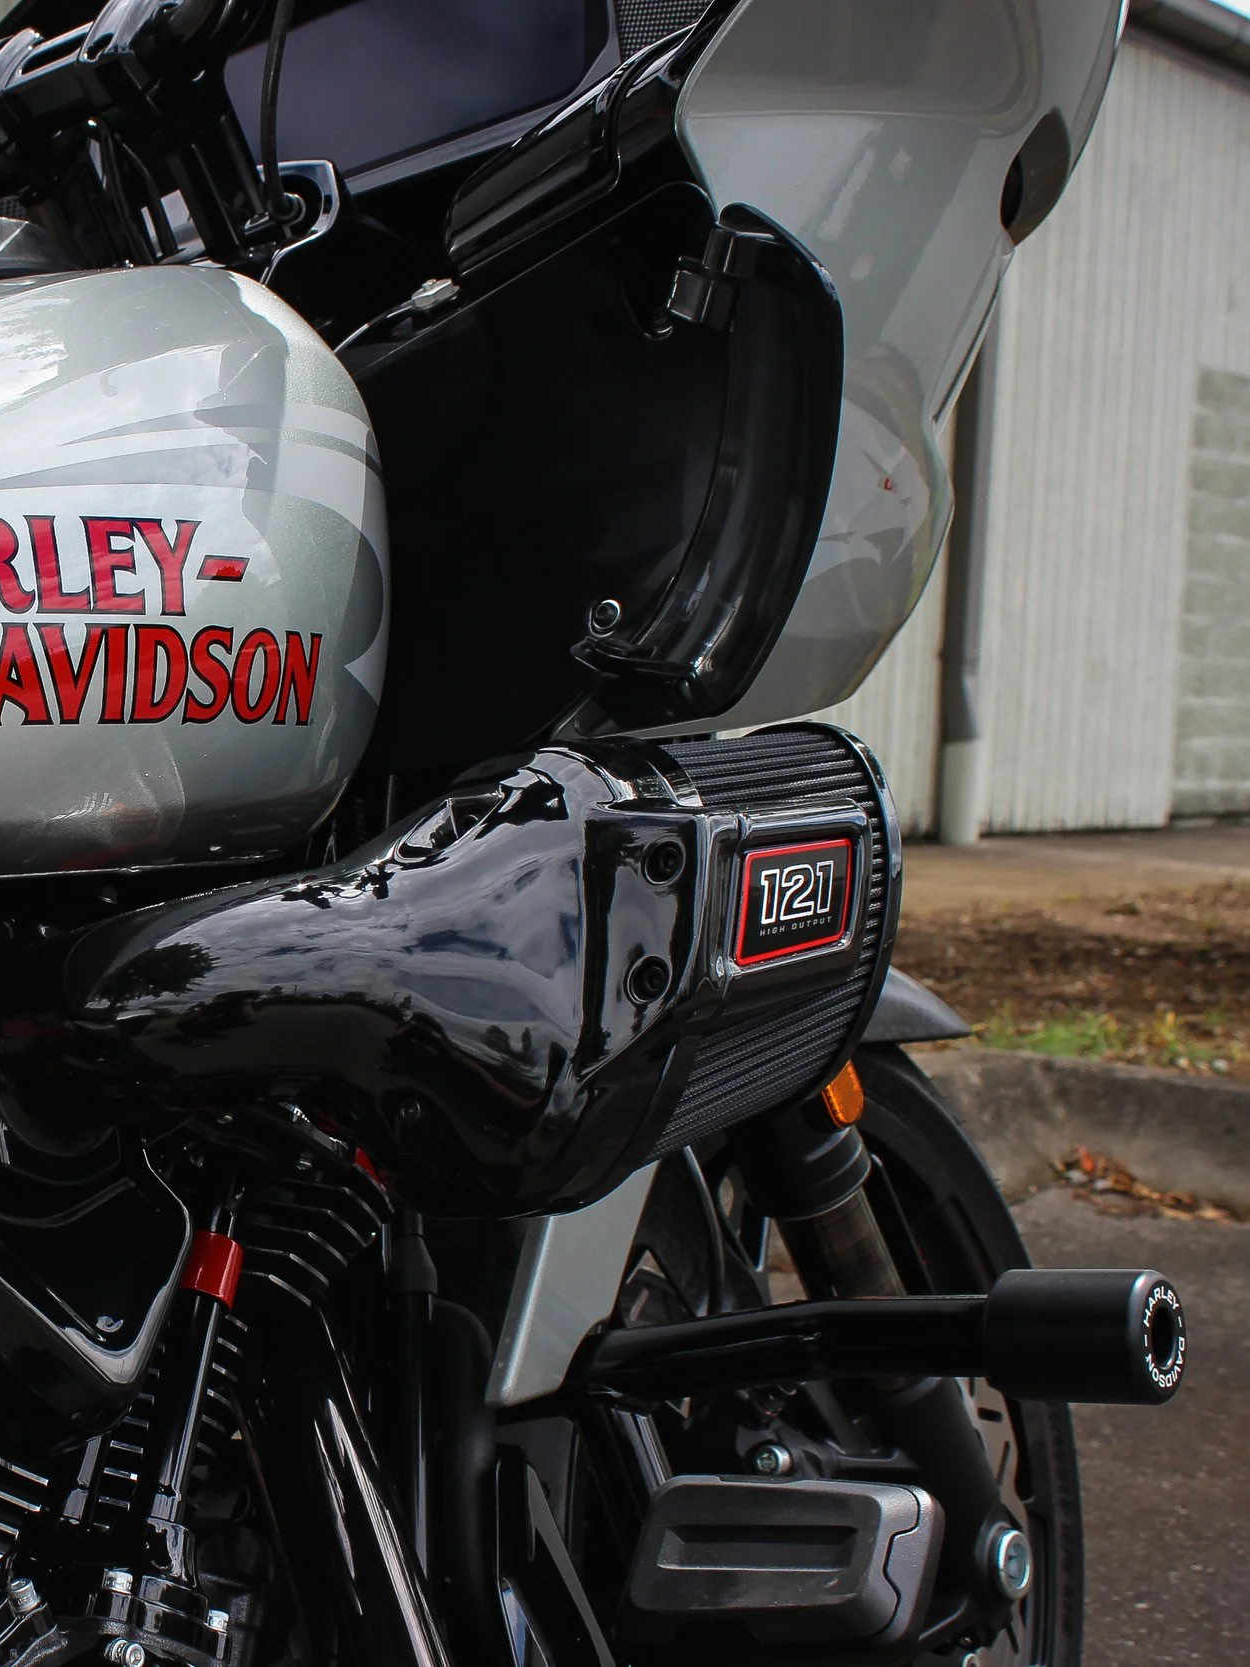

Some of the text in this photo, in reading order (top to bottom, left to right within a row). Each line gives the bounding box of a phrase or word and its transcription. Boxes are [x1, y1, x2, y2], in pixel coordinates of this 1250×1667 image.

[760, 860, 834, 925] 121
[759, 916, 833, 936] HIGH OUTPUT
[1143, 1286, 1186, 1388] HARLEY DAVIDSON
